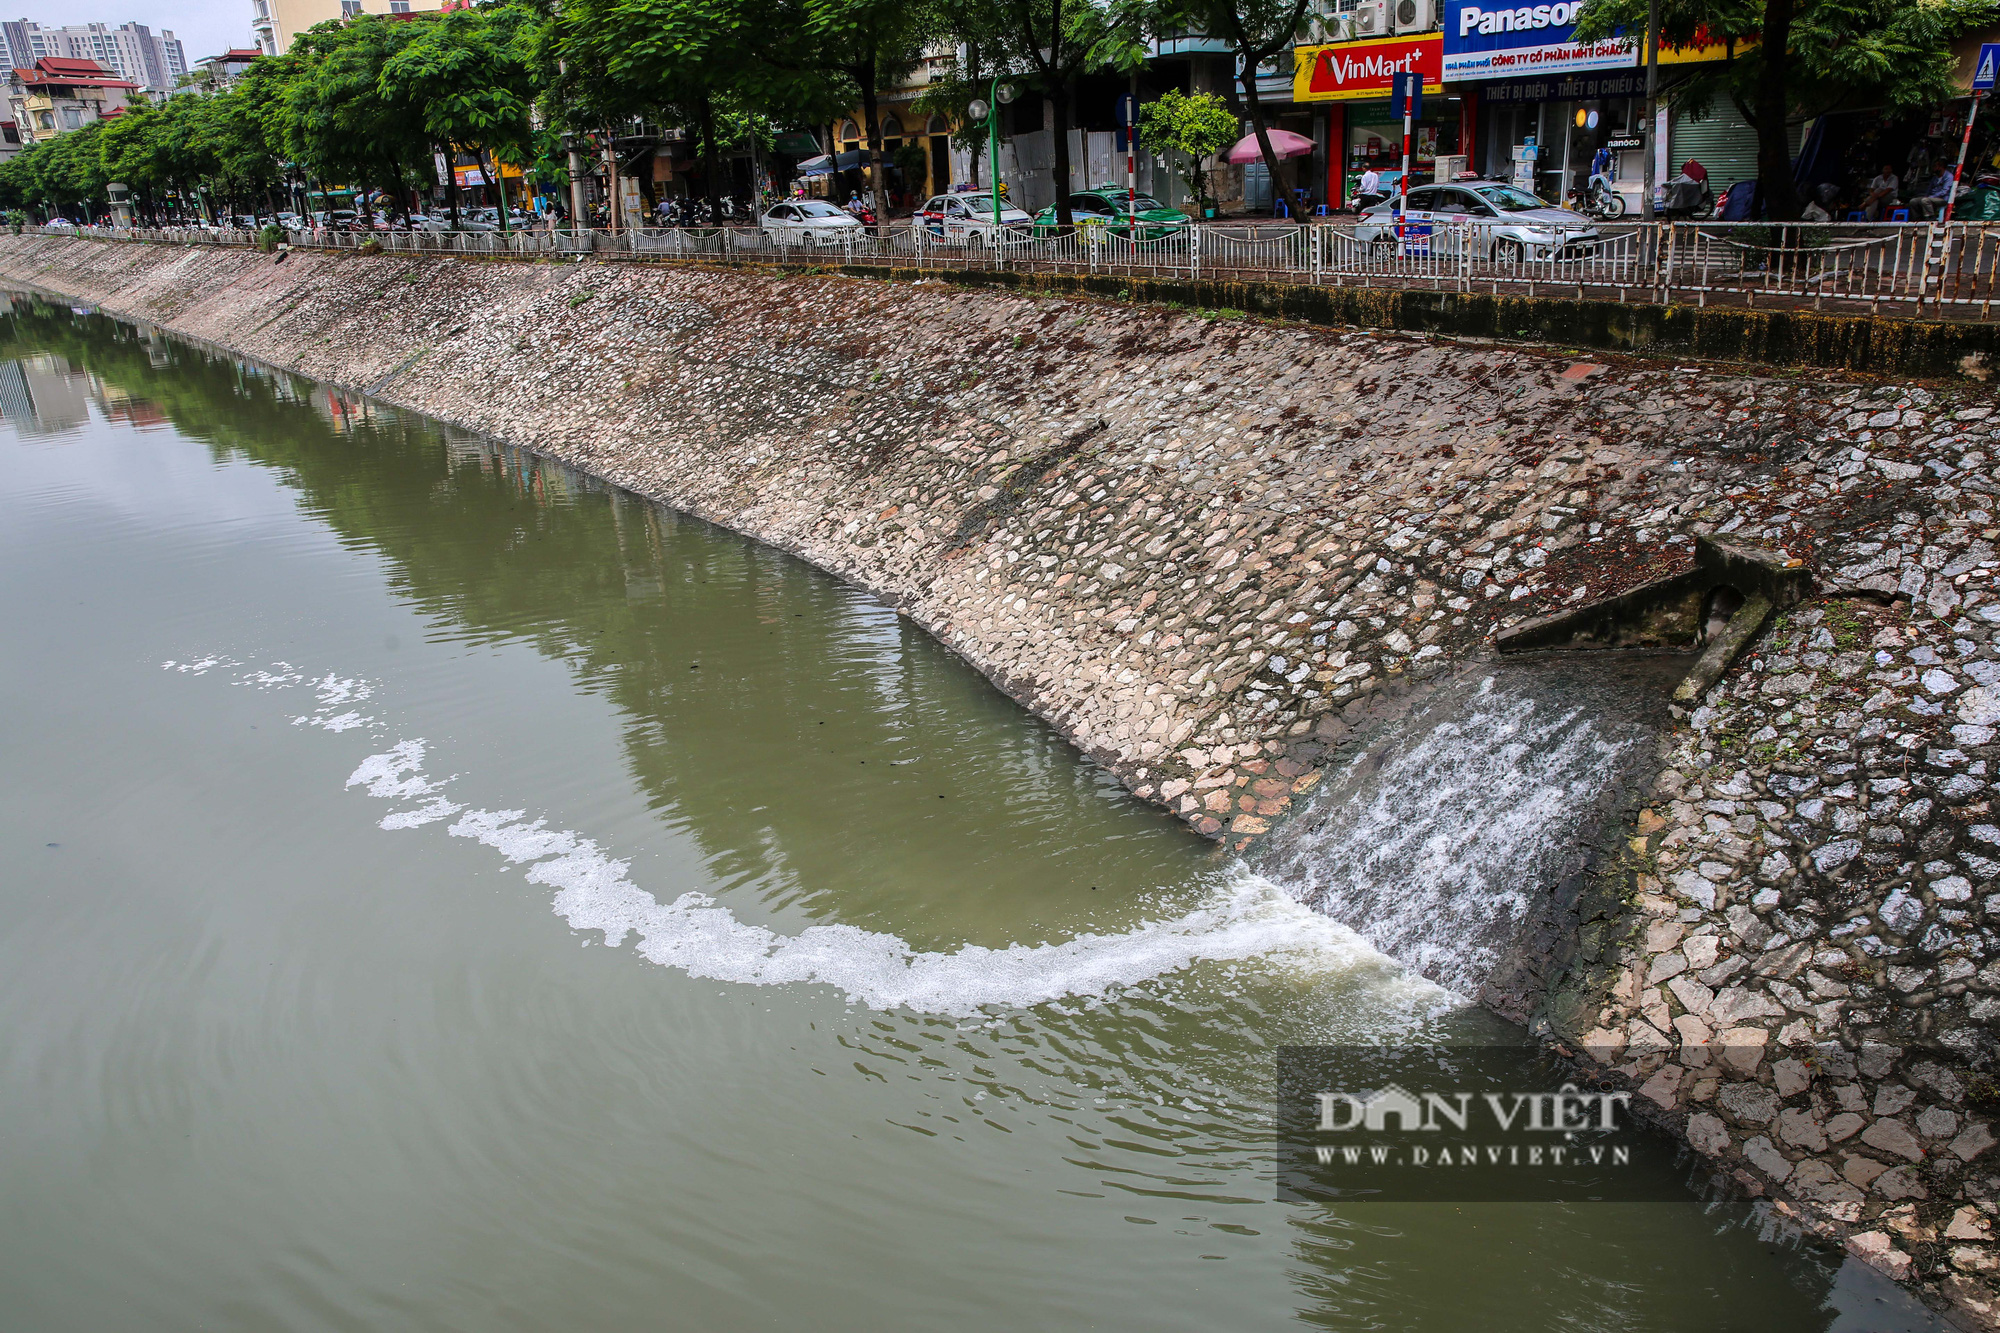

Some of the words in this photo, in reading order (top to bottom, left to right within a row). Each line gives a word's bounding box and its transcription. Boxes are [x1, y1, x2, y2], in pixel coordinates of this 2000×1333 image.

[1491, 54, 1515, 67] CÔNG
[1517, 54, 1529, 64] TY
[1486, 81, 1511, 100] THIẾT
[1513, 85, 1522, 101] BỊ
[1525, 81, 1548, 100] ĐIỆN
[1558, 76, 1585, 97] THIẾT
[1587, 80, 1598, 97] BỊ
[1601, 73, 1633, 94] CHIẾU
